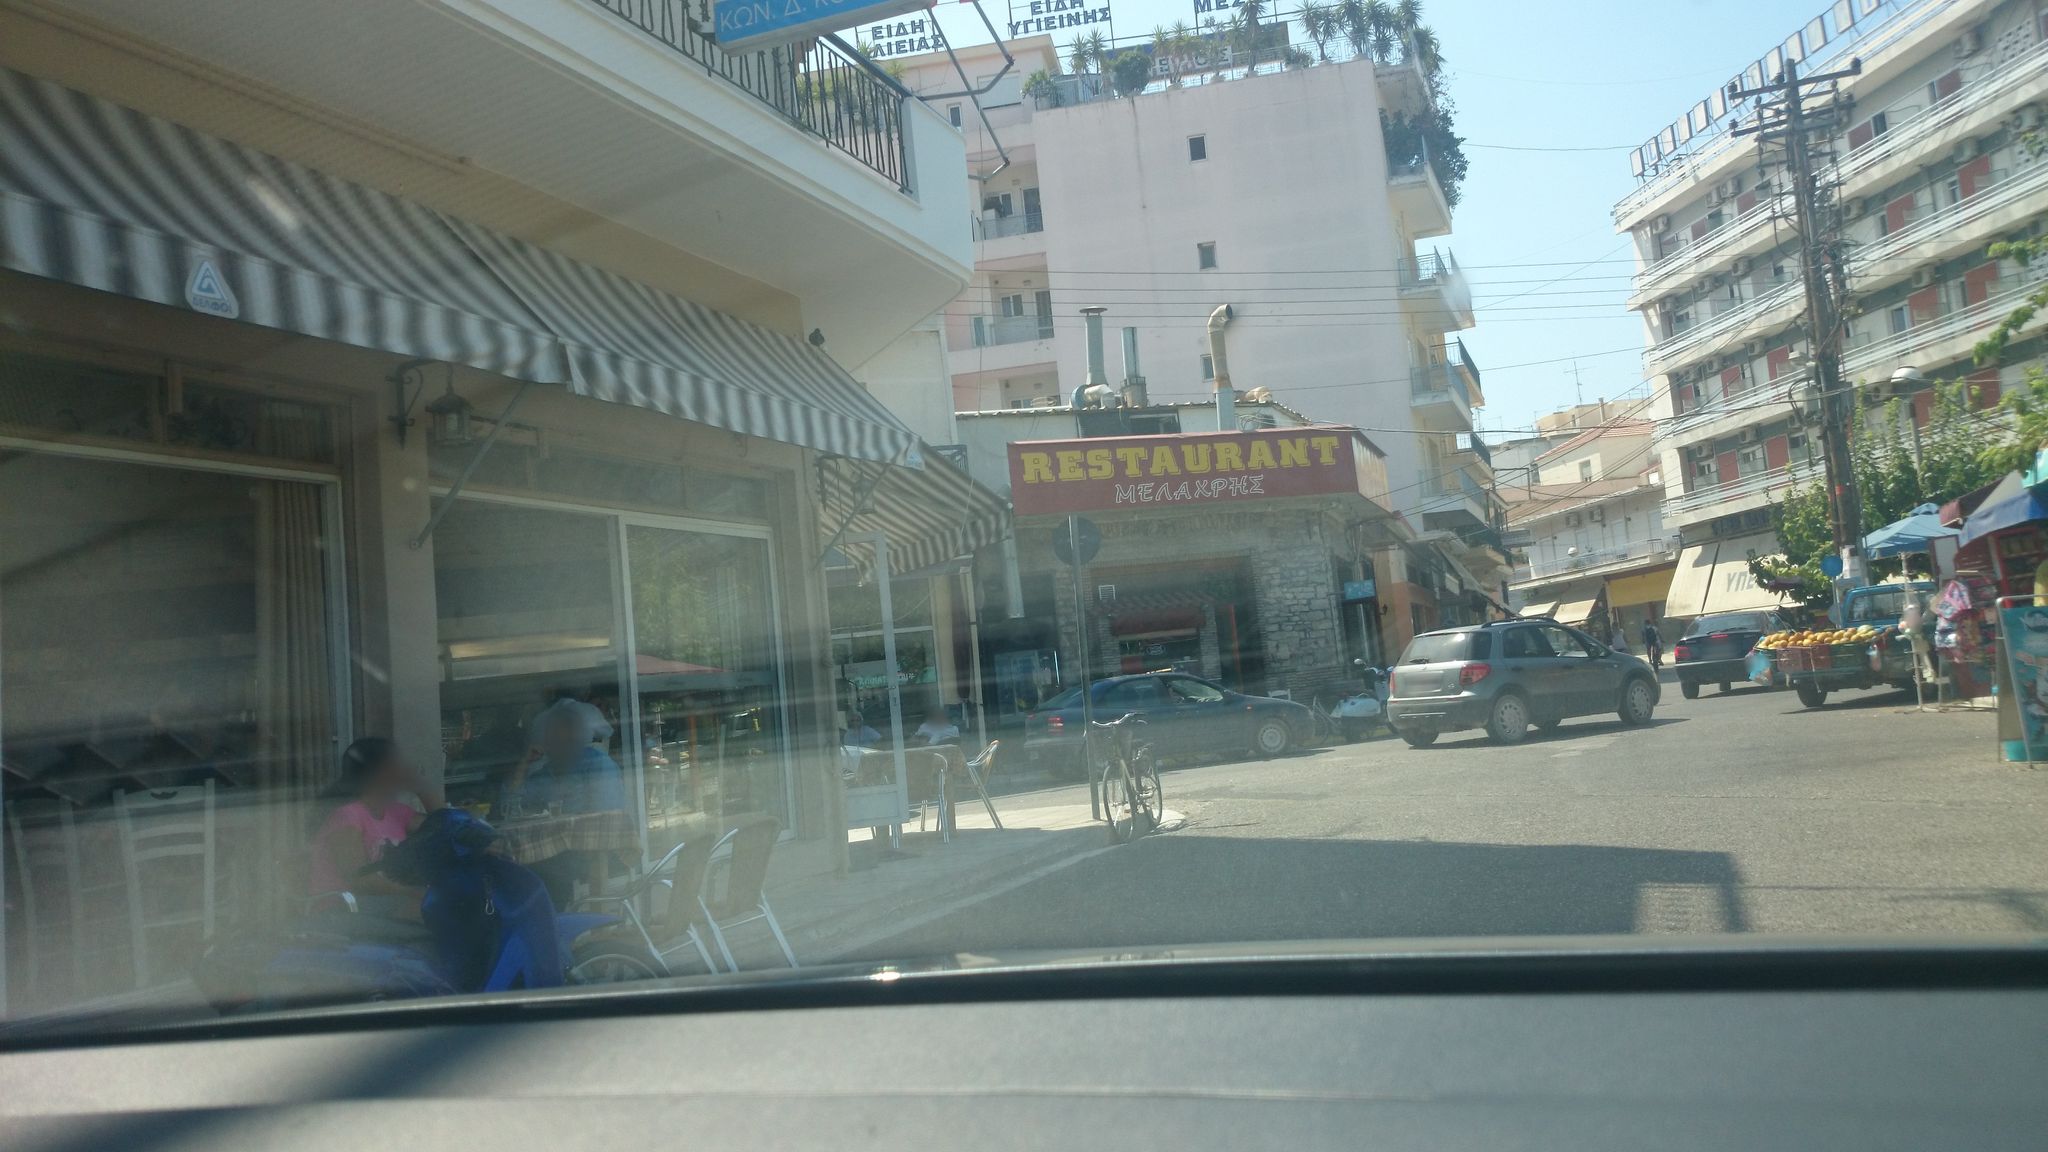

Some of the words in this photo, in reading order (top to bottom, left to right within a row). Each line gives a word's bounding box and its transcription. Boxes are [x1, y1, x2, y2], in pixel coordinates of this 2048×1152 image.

[719, 3, 776, 32] ΚΩΝ.
[872, 19, 925, 41] ΕΙΔΗ
[1008, 7, 1112, 36] ΥΓΙΕΙΝΗΣ
[870, 34, 944, 59] ΛΙΕΙΑΣ
[1020, 436, 1339, 484] RESTAURANT
[1114, 474, 1265, 504] ΜΕΛΑΧΡΗΣ
